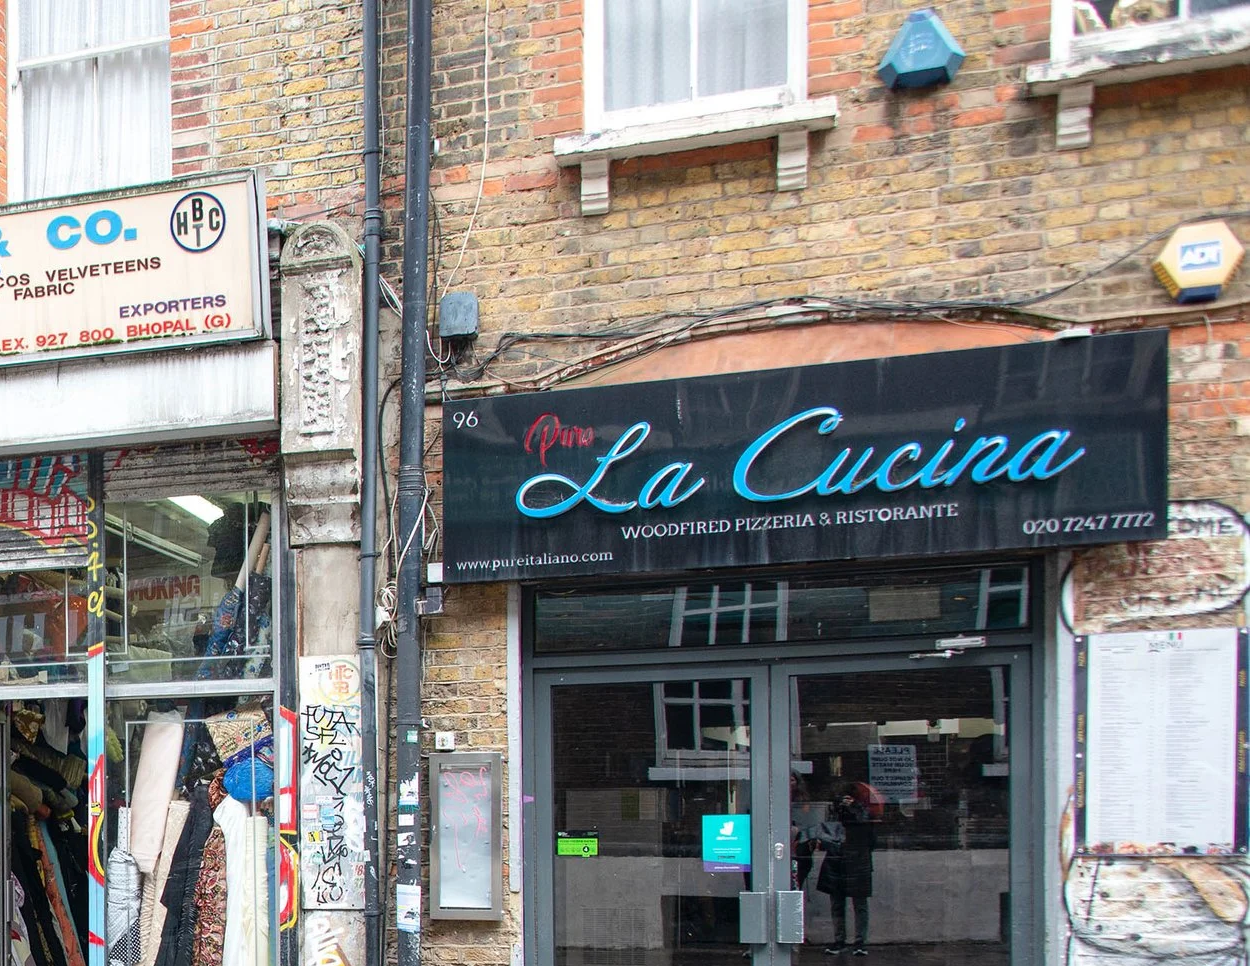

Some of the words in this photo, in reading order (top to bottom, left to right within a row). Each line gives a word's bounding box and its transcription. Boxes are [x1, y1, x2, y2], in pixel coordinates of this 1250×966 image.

[46, 209, 138, 250] CO.
[45, 256, 162, 283] VELVETEENS
[13, 282, 76, 300] FABRIC
[119, 294, 227, 319] EXPORTERS
[36, 332, 68, 348] 927
[79, 327, 115, 343] 800
[126, 318, 196, 338] BHOPAL
[204, 314, 232, 329] (G)
[452, 411, 479, 429] 96
[516, 421, 705, 518] La
[733, 406, 1086, 503] Cucina
[621, 519, 730, 540] WOODFIRED
[735, 513, 816, 533] PIZZERIA
[819, 511, 831, 526] &
[835, 503, 960, 525] RISTORANTE
[1023, 519, 1060, 535] 020
[1063, 515, 1106, 533] 7247
[1111, 512, 1156, 530] 7772
[456, 549, 613, 573] www.pureitaliano.com
